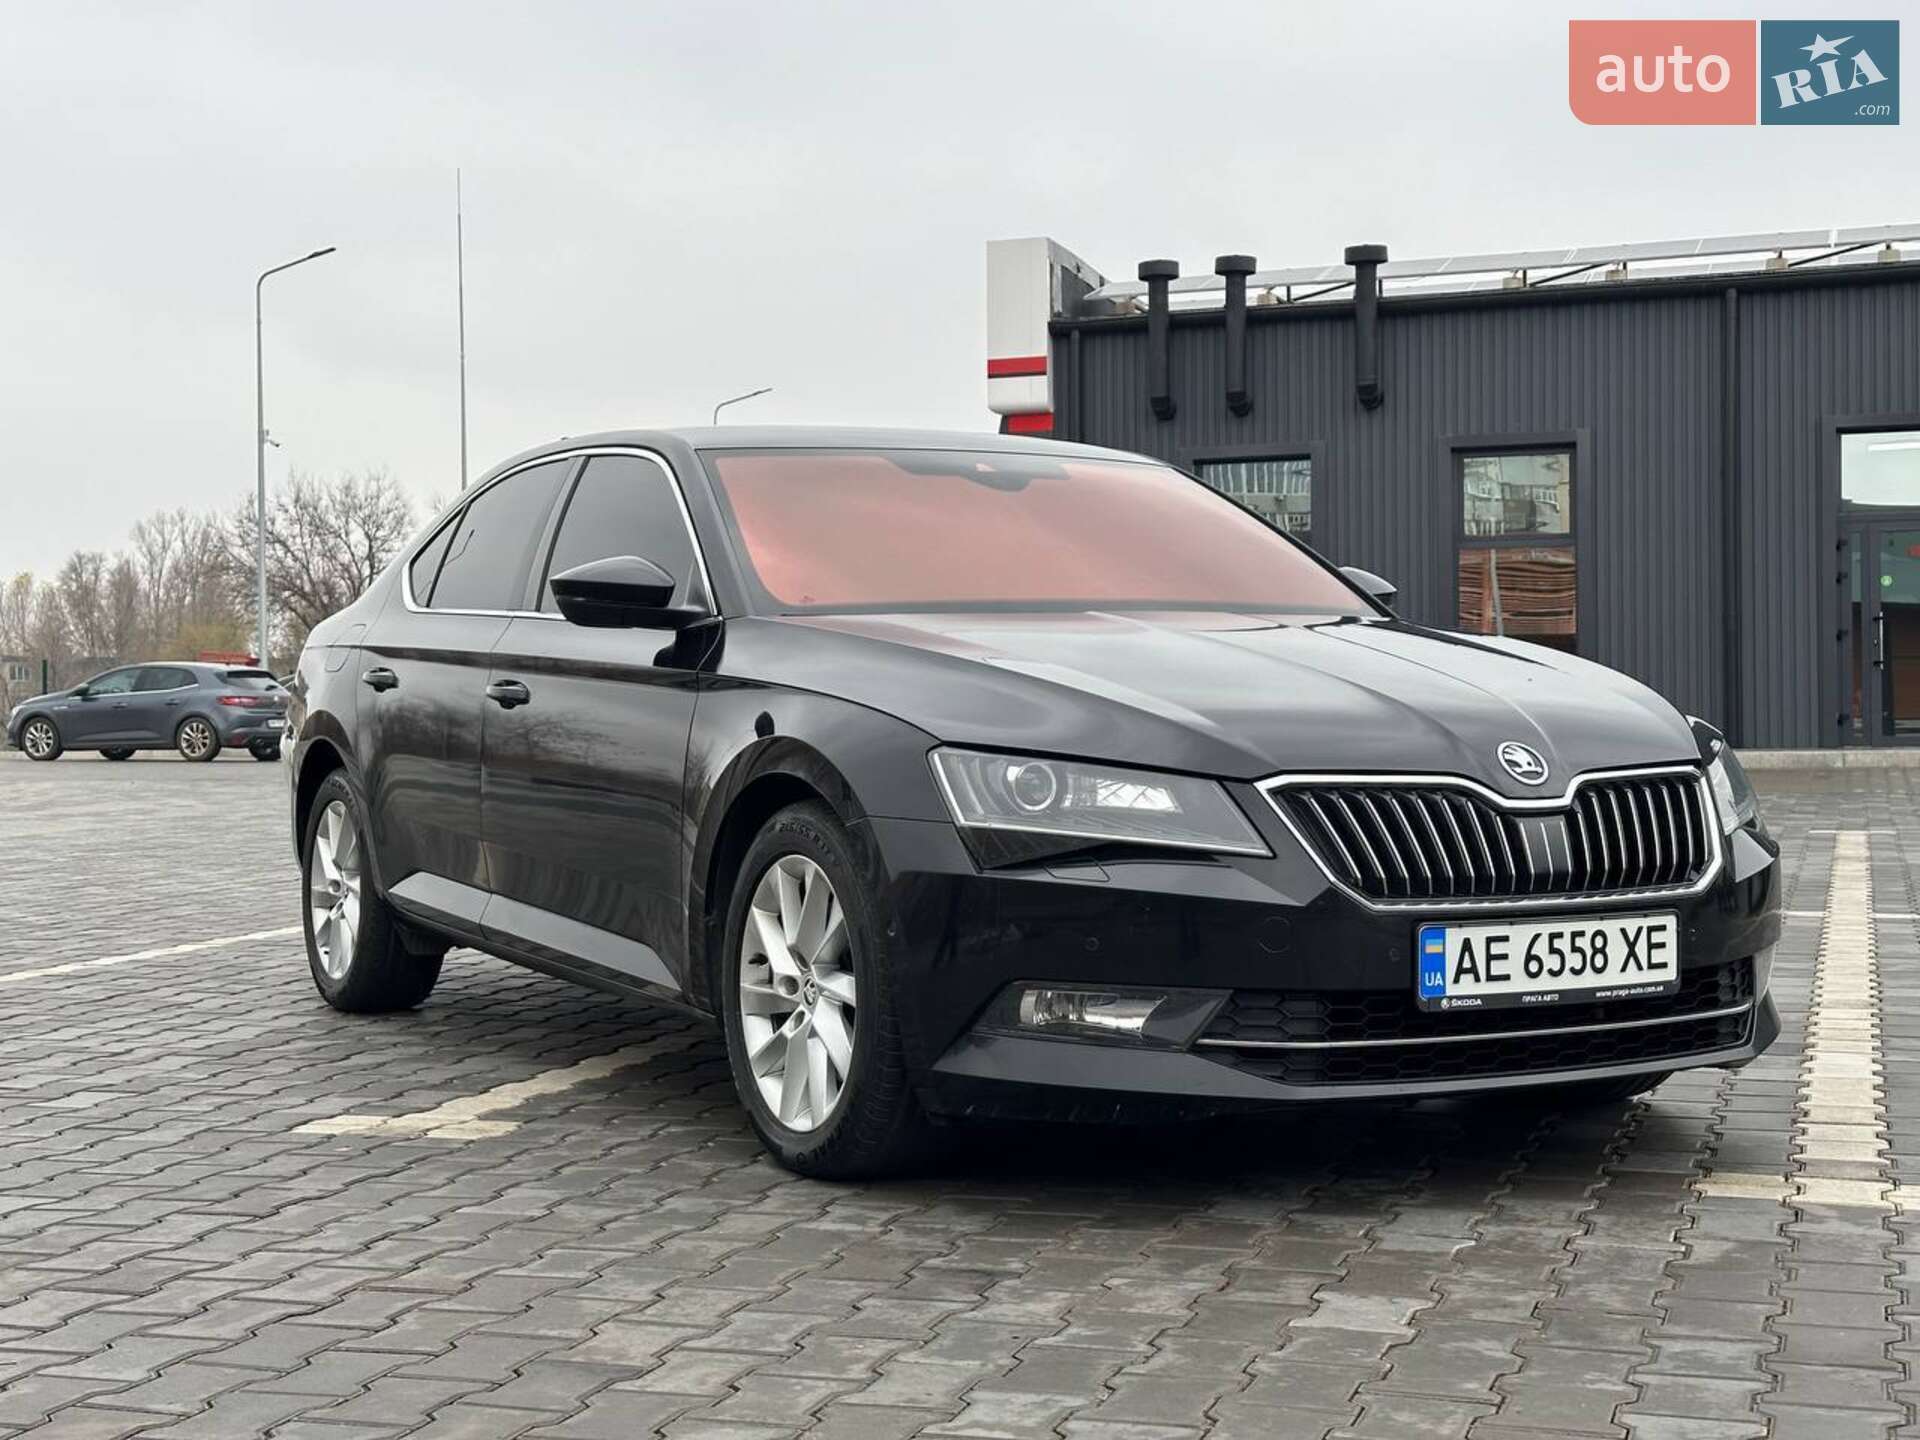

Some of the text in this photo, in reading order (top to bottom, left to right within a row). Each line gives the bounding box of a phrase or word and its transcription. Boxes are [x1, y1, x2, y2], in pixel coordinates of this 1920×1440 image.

[1452, 924, 1668, 984] AE 6558 XE
[1425, 972, 1444, 986] UA
